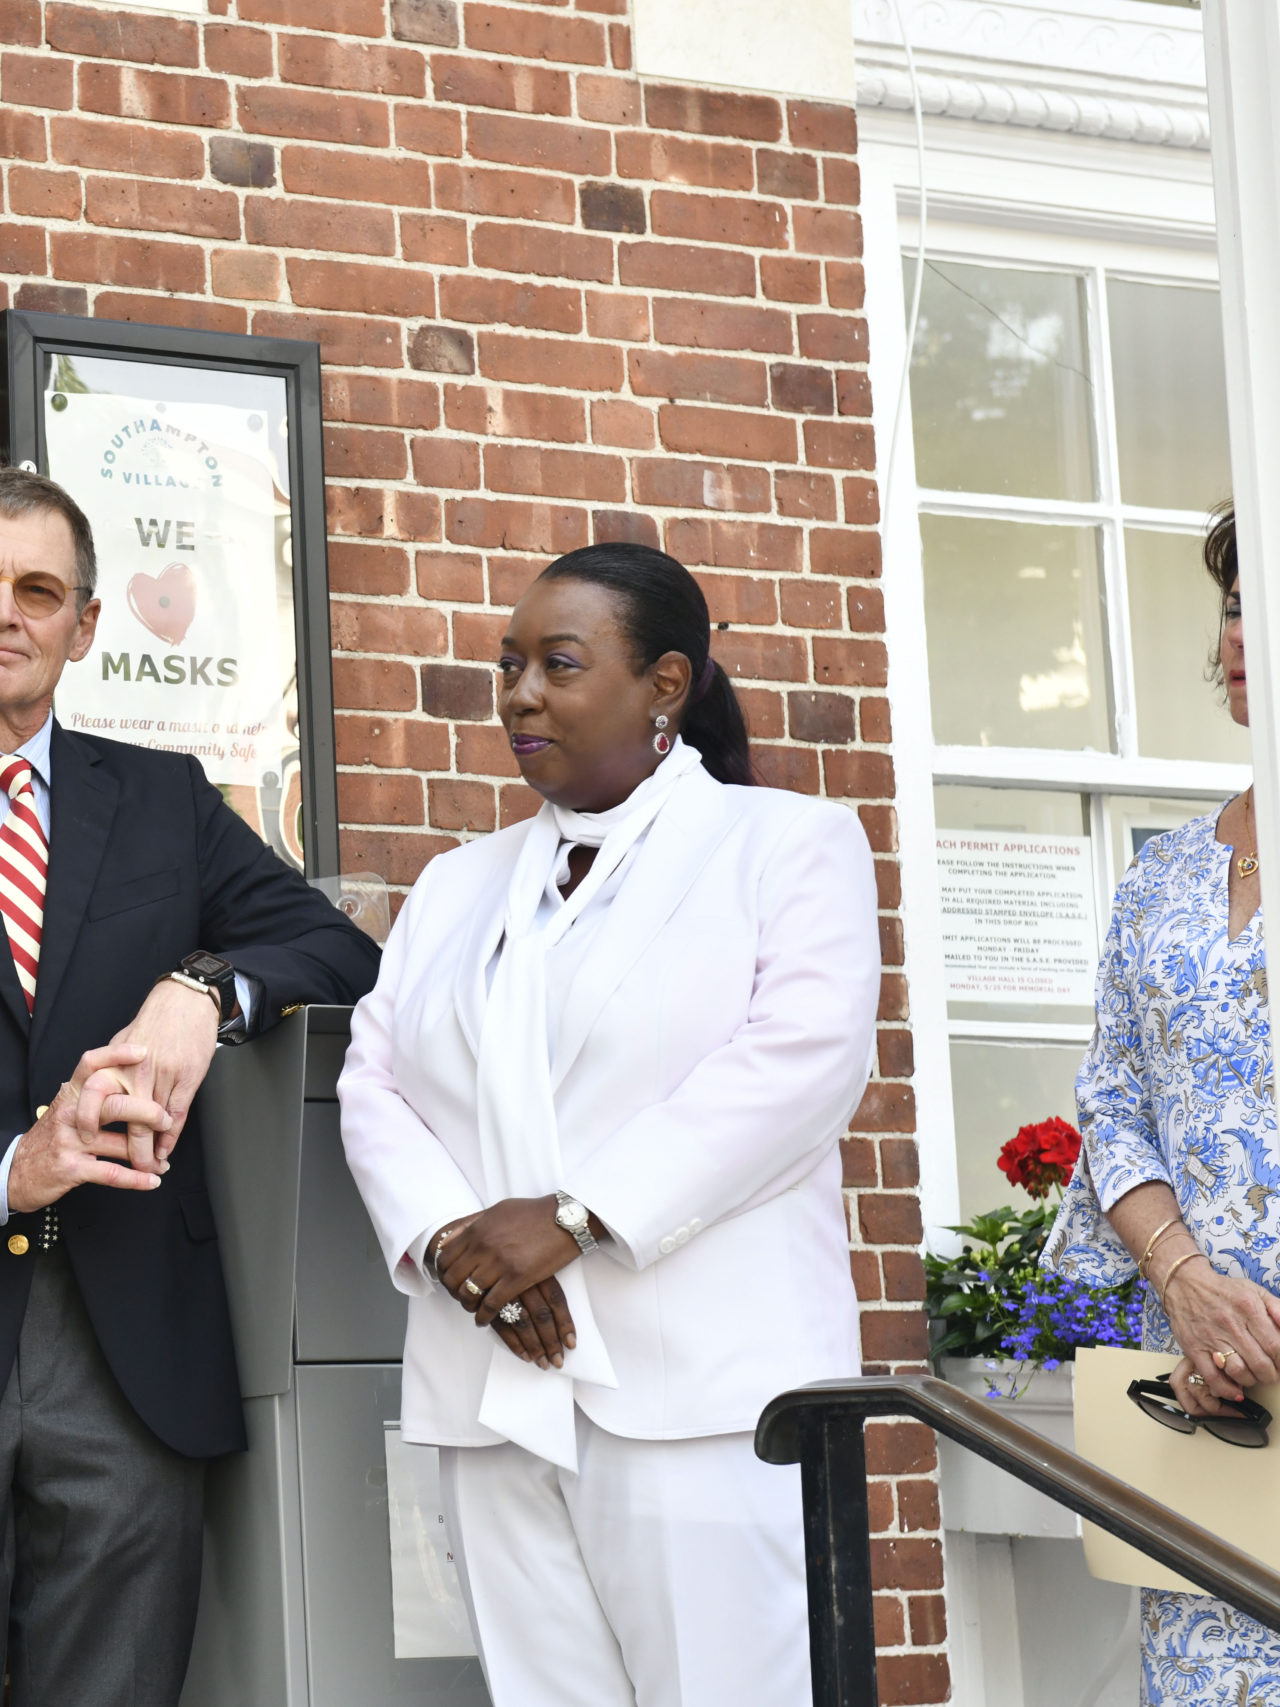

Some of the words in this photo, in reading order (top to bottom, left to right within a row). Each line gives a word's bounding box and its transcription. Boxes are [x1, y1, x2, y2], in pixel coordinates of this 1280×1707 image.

[100, 418, 224, 489] SOUTHAMPTON
[134, 516, 196, 552] WE
[101, 651, 240, 688] MASKS
[70, 711, 117, 732] Please
[120, 717, 155, 732] wear
[157, 720, 167, 732] a
[228, 740, 258, 763] Safe
[960, 841, 1000, 853] PERMIT
[1003, 843, 1081, 856] APPLICATIONS
[956, 859, 985, 868] FOLLOW
[987, 861, 999, 869] THE
[1002, 862, 1054, 872] INSTRUCTIONS
[1056, 865, 1076, 873] WHEN
[948, 868, 993, 878] COMPLETING
[995, 870, 1008, 878] THE
[974, 888, 993, 896] YOUR
[994, 889, 1035, 899] COMPLETED
[1037, 891, 1083, 901] APPLICATION
[952, 897, 965, 905] ALL
[966, 898, 1002, 907] REQUIRED
[1003, 900, 1038, 909] MATERIAL
[985, 908, 1017, 918] STAMPED
[974, 918, 983, 926] IN
[985, 918, 1001, 926] THIS
[1003, 919, 1023, 928] DROP
[960, 935, 1012, 945] APPLICATIONS
[1013, 937, 1030, 946] WILL
[1032, 938, 1042, 946] BE
[976, 945, 1008, 953] MONDAY
[1013, 946, 1039, 955] FRIDAY
[944, 953, 972, 962] MAILED
[974, 954, 983, 963] TO
[985, 955, 999, 963] YOU
[1001, 956, 1009, 964] IN
[1011, 956, 1024, 965] THE
[1053, 957, 1089, 967] PROVIDED
[967, 974, 996, 984] VILLAGE
[998, 975, 1015, 985] HALL
[1017, 976, 1025, 985] IS
[1003, 985, 1017, 993] FOR
